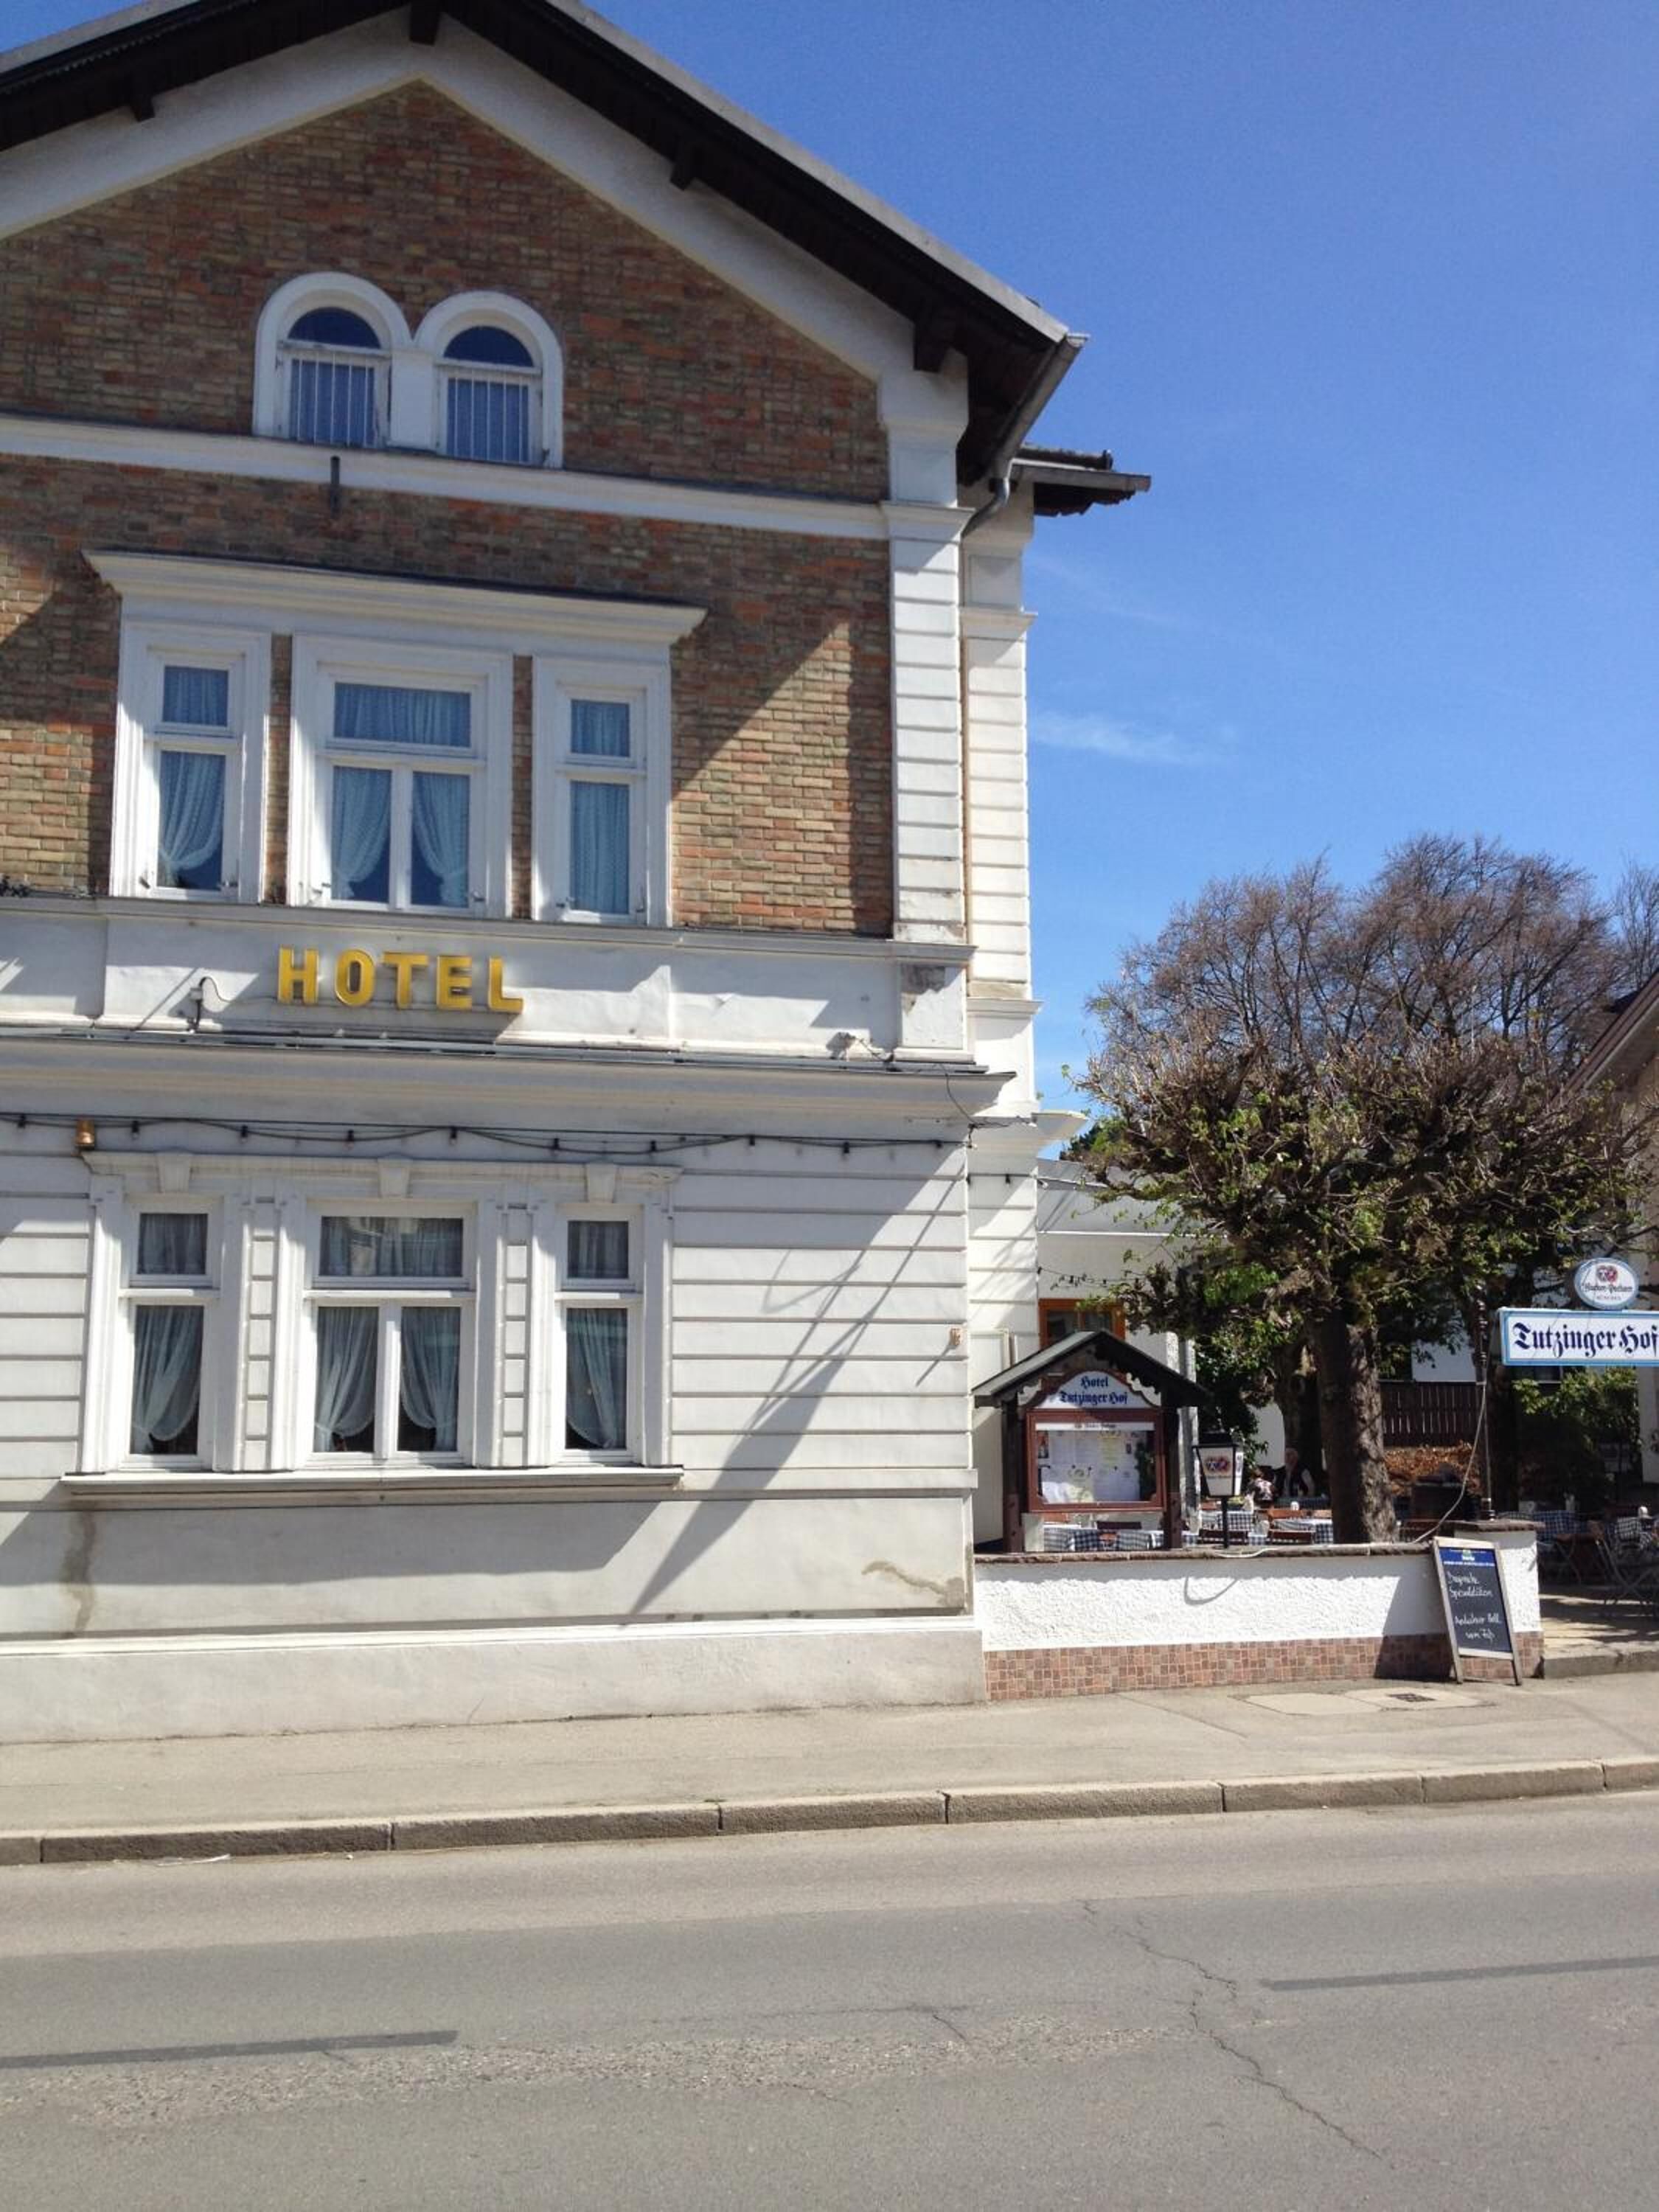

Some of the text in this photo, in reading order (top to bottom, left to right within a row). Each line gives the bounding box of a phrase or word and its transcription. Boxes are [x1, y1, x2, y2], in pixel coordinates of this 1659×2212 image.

[277, 947, 524, 1013] HOTEL
[1513, 1322, 1659, 1357] Tutzinger Hof
[1080, 1376, 1109, 1388] Hotel
[1059, 1391, 1127, 1405] Tutzinger Hof
